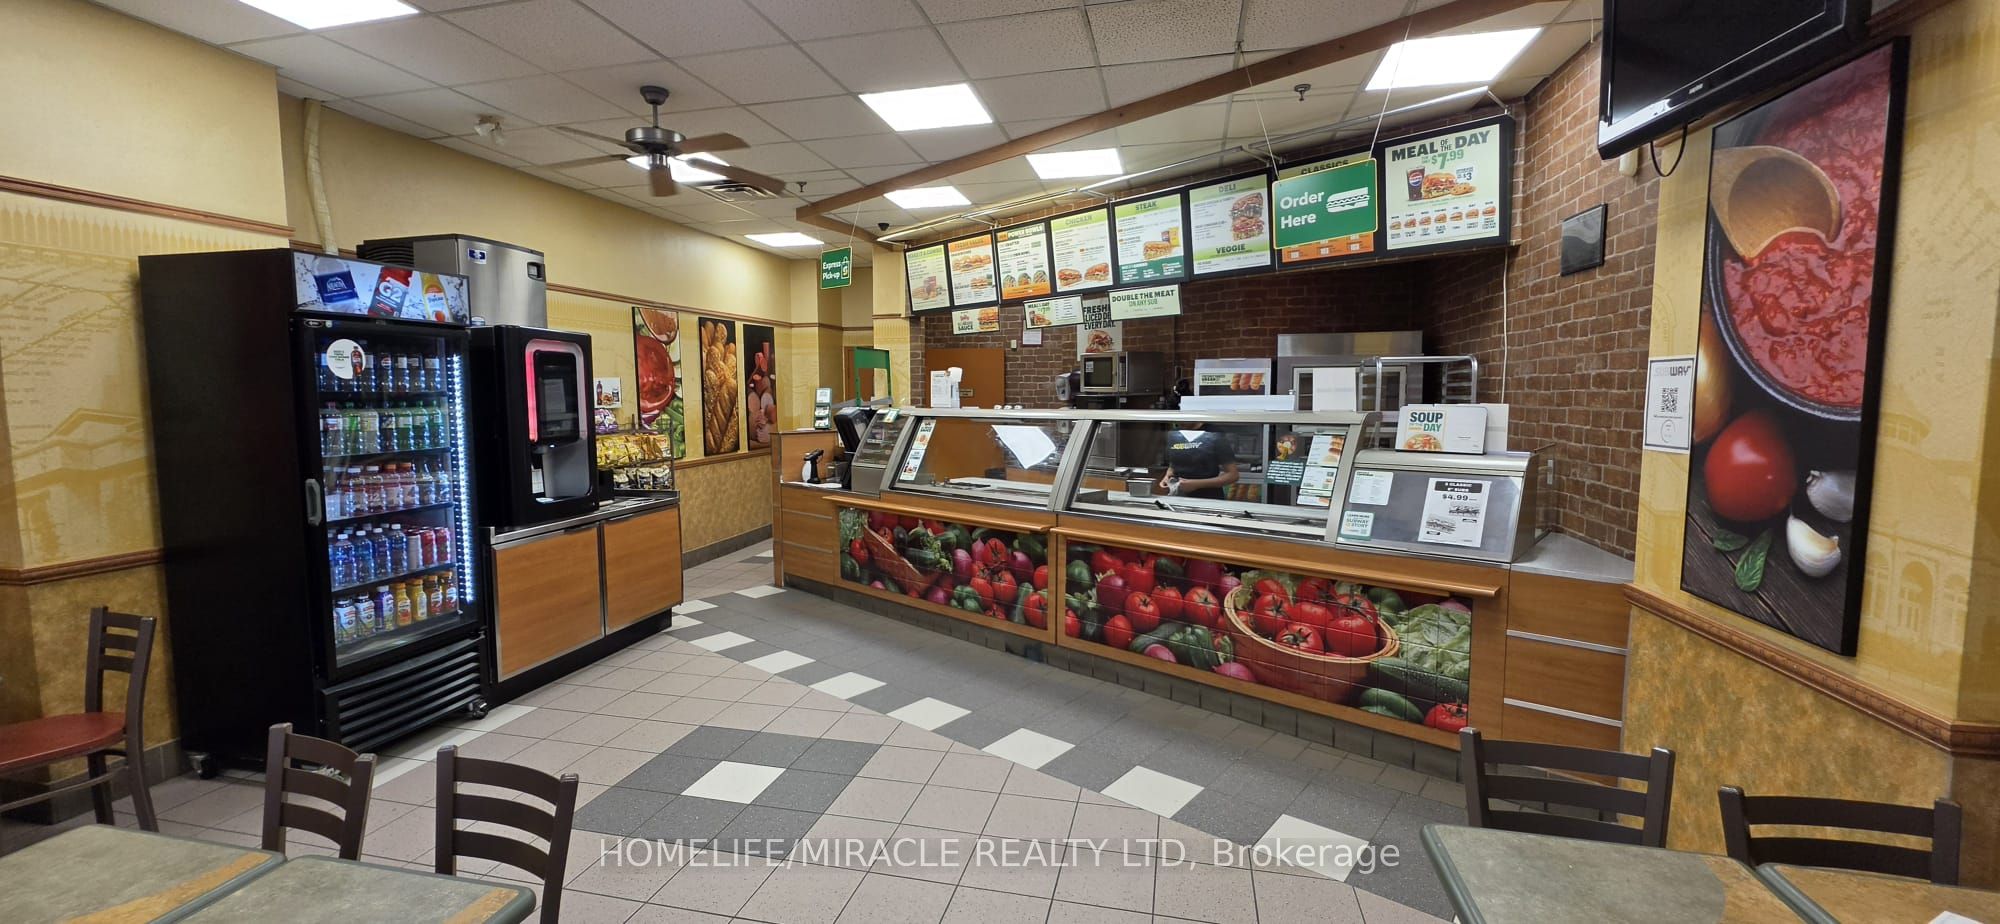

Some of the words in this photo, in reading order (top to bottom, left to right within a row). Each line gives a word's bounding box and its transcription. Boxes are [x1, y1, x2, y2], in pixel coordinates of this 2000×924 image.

[1391, 142, 1438, 162] MEAL
[1454, 130, 1491, 149] DAY
[1440, 143, 1452, 152] THE
[1431, 149, 1465, 170] $7.99
[1463, 172, 1472, 181] $3
[1218, 183, 1237, 193] DELI
[1135, 200, 1157, 211] STEAK
[1279, 191, 1325, 210] Order
[1280, 213, 1317, 229] Here
[1216, 243, 1246, 254] VEGGIE
[823, 261, 841, 270] Express
[379, 281, 403, 302] G2
[1112, 293, 1139, 303] DOUBLE
[1139, 291, 1153, 299] THE
[1154, 289, 1176, 298] MEAT
[1147, 298, 1158, 306] SUB
[1084, 321, 1103, 331] EVERY
[1653, 365, 1692, 377] SUBWAY
[1409, 411, 1443, 423] SOUP
[1423, 423, 1442, 433] DAY
[1442, 493, 1469, 501] $4.99
